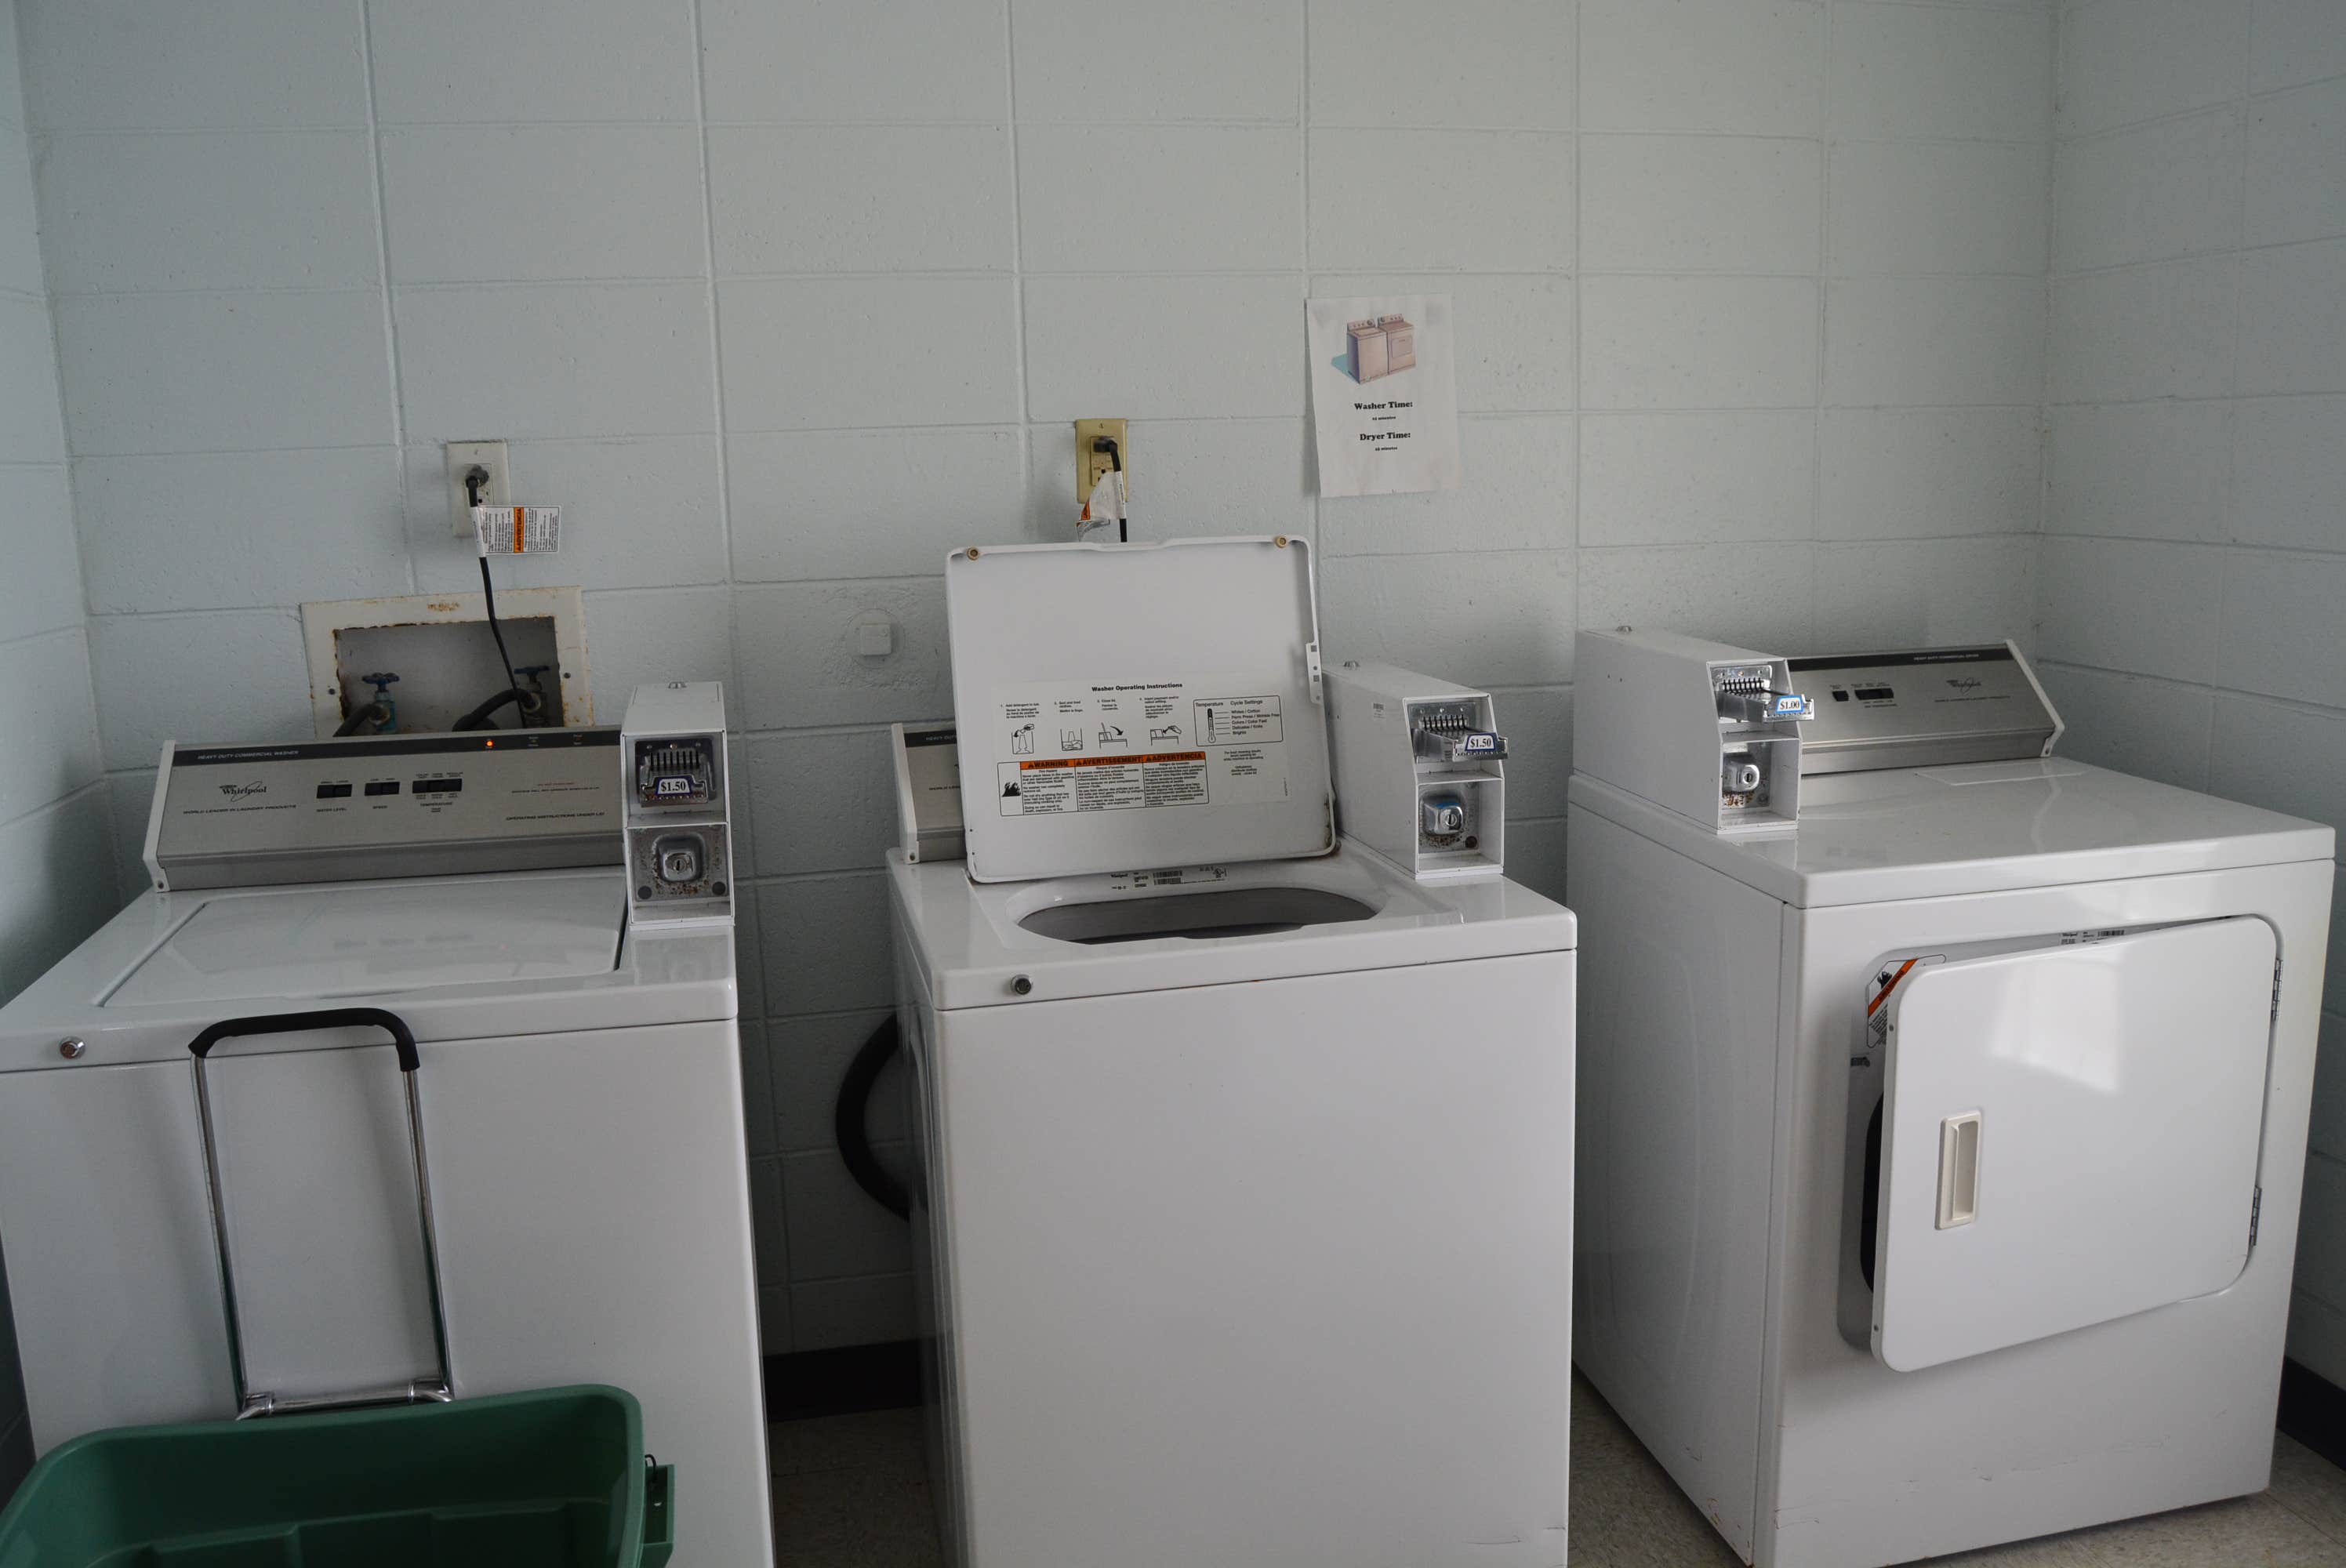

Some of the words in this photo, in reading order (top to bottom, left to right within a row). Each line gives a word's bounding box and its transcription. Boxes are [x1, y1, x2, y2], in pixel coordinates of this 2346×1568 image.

[1780, 700, 1800, 710] $1.00
[1469, 738, 1491, 749] $1.50
[1154, 753, 1202, 761] ADVERTENCIA
[660, 781, 687, 793] $1.50
